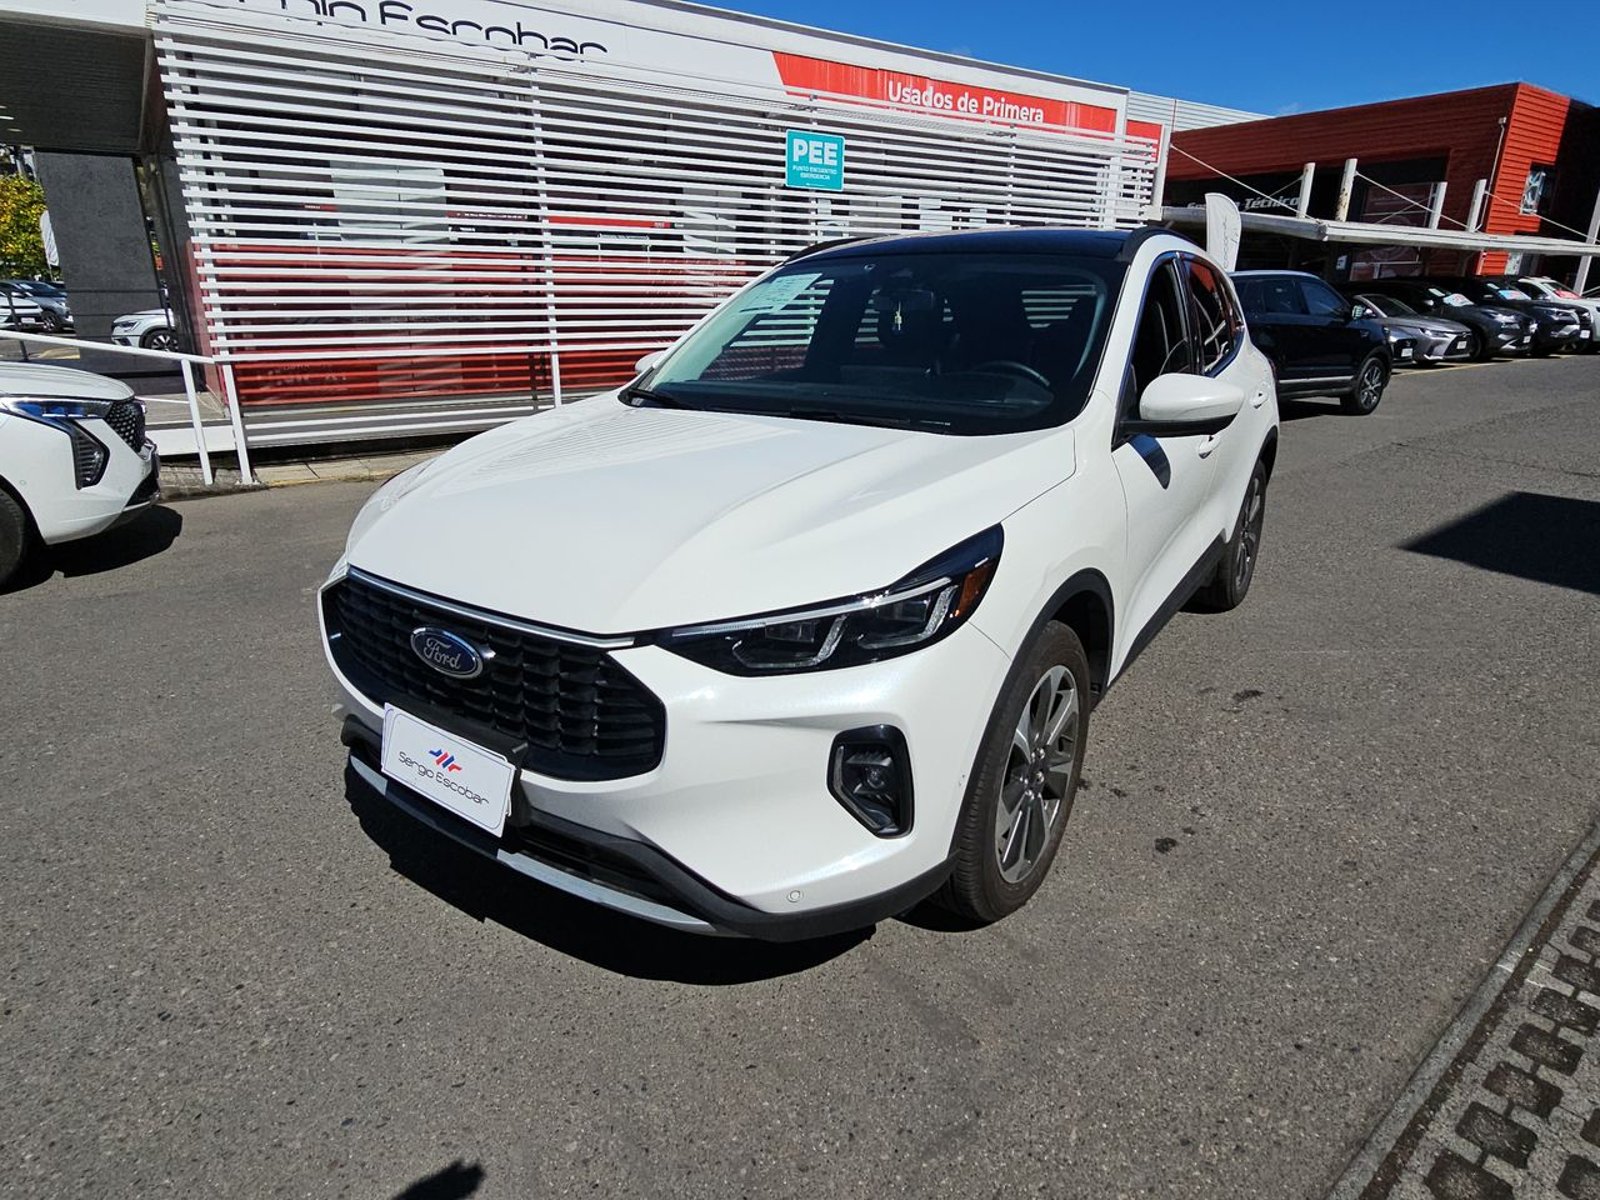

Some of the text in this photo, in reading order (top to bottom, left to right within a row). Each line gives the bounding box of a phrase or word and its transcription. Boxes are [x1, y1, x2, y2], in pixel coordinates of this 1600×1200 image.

[888, 80, 1044, 123] Usados de Primera
[793, 138, 838, 166] PEE
[423, 637, 461, 670] Ford
[435, 771, 490, 805] Escobar
